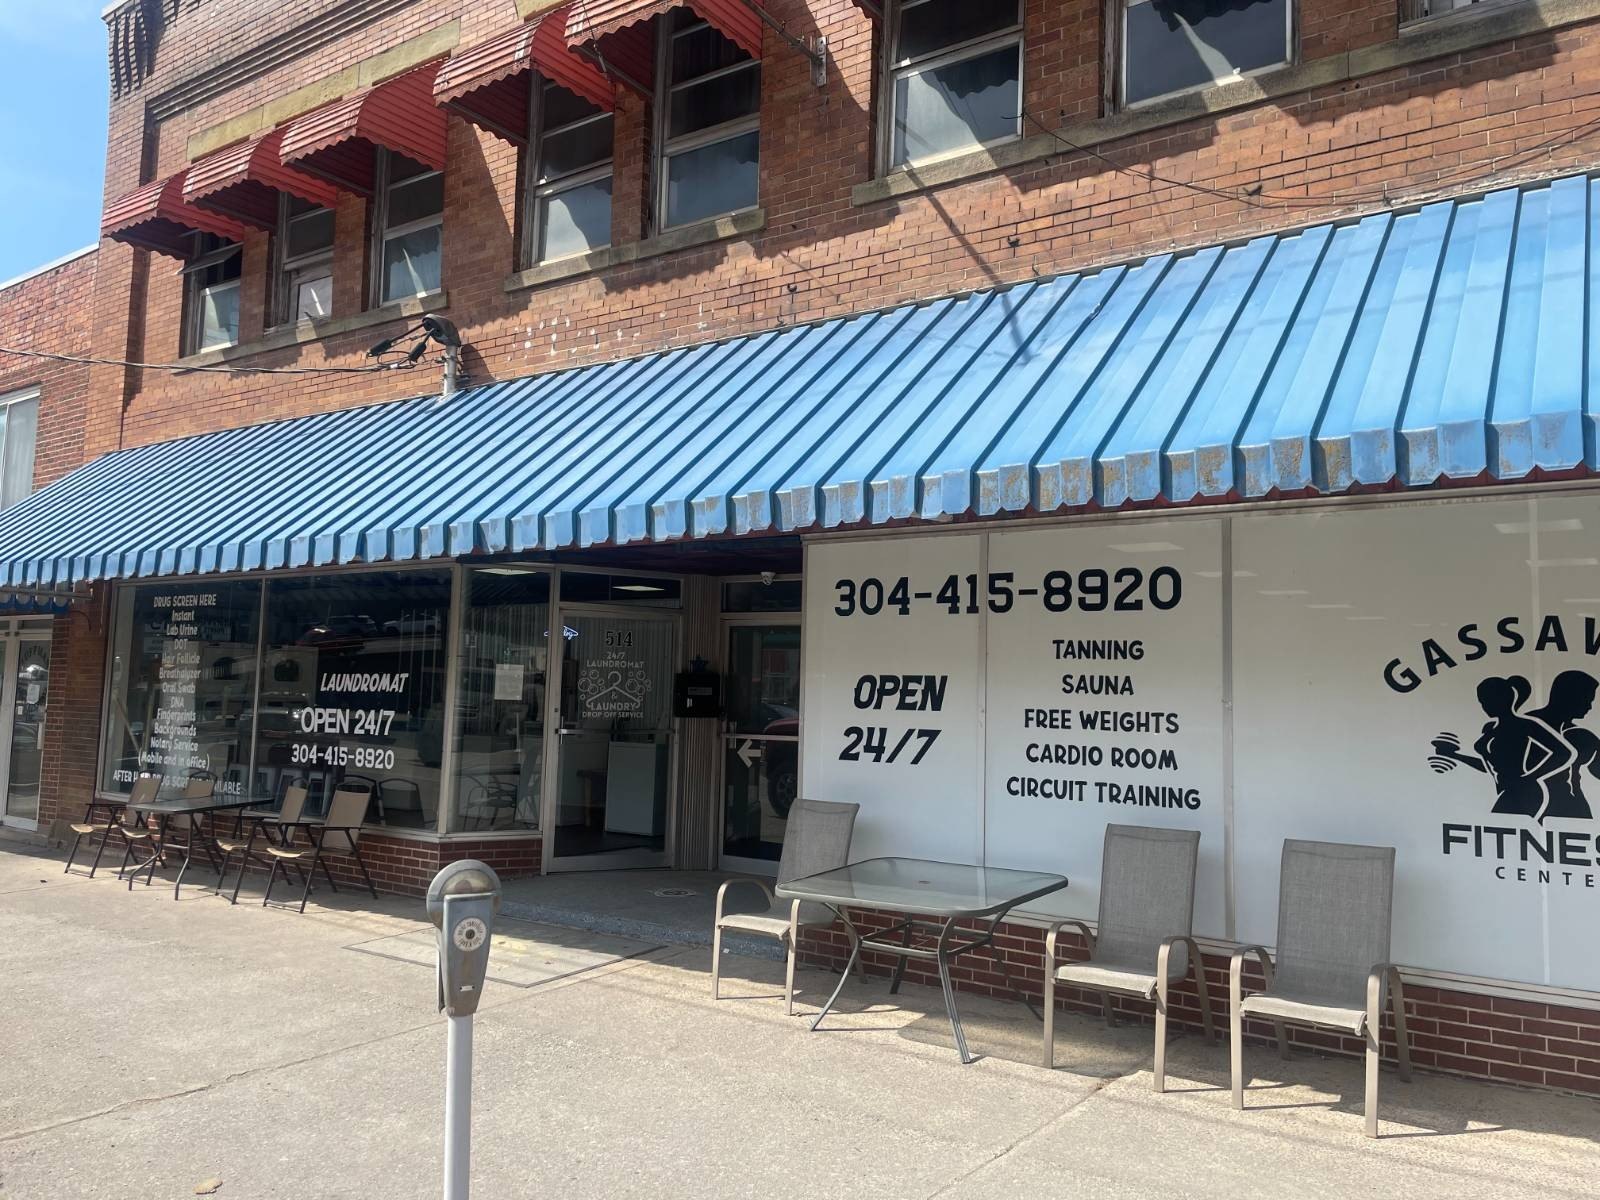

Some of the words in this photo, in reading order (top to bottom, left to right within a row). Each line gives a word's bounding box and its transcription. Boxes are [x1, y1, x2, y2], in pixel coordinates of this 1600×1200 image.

[834, 566, 1182, 617] 304-415-8920
[153, 596, 171, 608] DRUG
[172, 594, 198, 607] SCREEN
[199, 593, 217, 606] HERE
[172, 609, 195, 622] Instant
[166, 623, 178, 636] Lab
[179, 624, 198, 636] Urine
[174, 638, 188, 650] DOT
[605, 631, 633, 647] 514
[1052, 640, 1145, 660] TANNING
[159, 666, 201, 680] Breathalyzer
[586, 660, 645, 669] LAUNDROMAT
[320, 672, 409, 693] LAUNDROMAT
[1061, 674, 1135, 696] SAUNA
[853, 674, 948, 712] OPEN
[590, 701, 636, 711] LAUNDRY
[156, 708, 196, 724] Fingerprints
[301, 706, 350, 734] OPEN
[354, 709, 396, 736] 24/7
[617, 711, 644, 719] SERVICE
[1024, 708, 1072, 730] FREE
[1079, 710, 1180, 734] WEIGHTS
[154, 721, 197, 739] Backgrounds
[151, 737, 173, 751] Notary
[173, 739, 198, 752] Service
[838, 726, 942, 765] 24/7
[163, 754, 177, 765] and
[178, 755, 185, 765] in
[291, 743, 395, 770] 304-415-8920
[1025, 743, 1103, 767] CARDIO
[1111, 747, 1178, 771] ROOM
[112, 769, 132, 783] AFTER
[1006, 777, 1088, 802] CIRCUIT
[1094, 782, 1201, 810] TRAINING
[1442, 823, 1600, 867] FITNE
